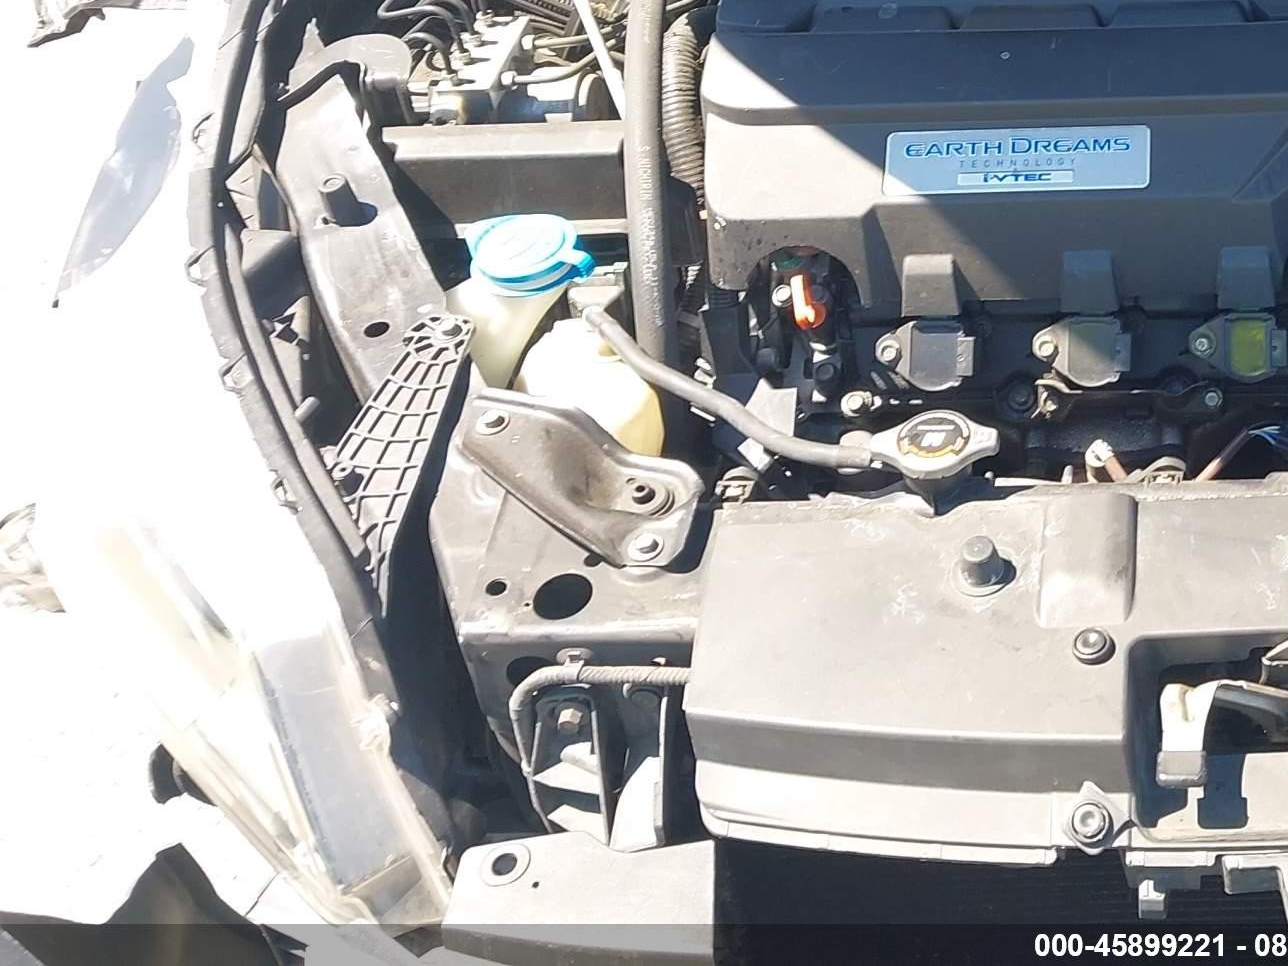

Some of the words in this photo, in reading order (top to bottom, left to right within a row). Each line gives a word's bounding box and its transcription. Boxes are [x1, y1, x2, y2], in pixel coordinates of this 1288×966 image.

[905, 141, 1001, 157] EARTH
[1011, 137, 1131, 154] DREAMS
[959, 158, 1077, 169] TECHNOLOGY
